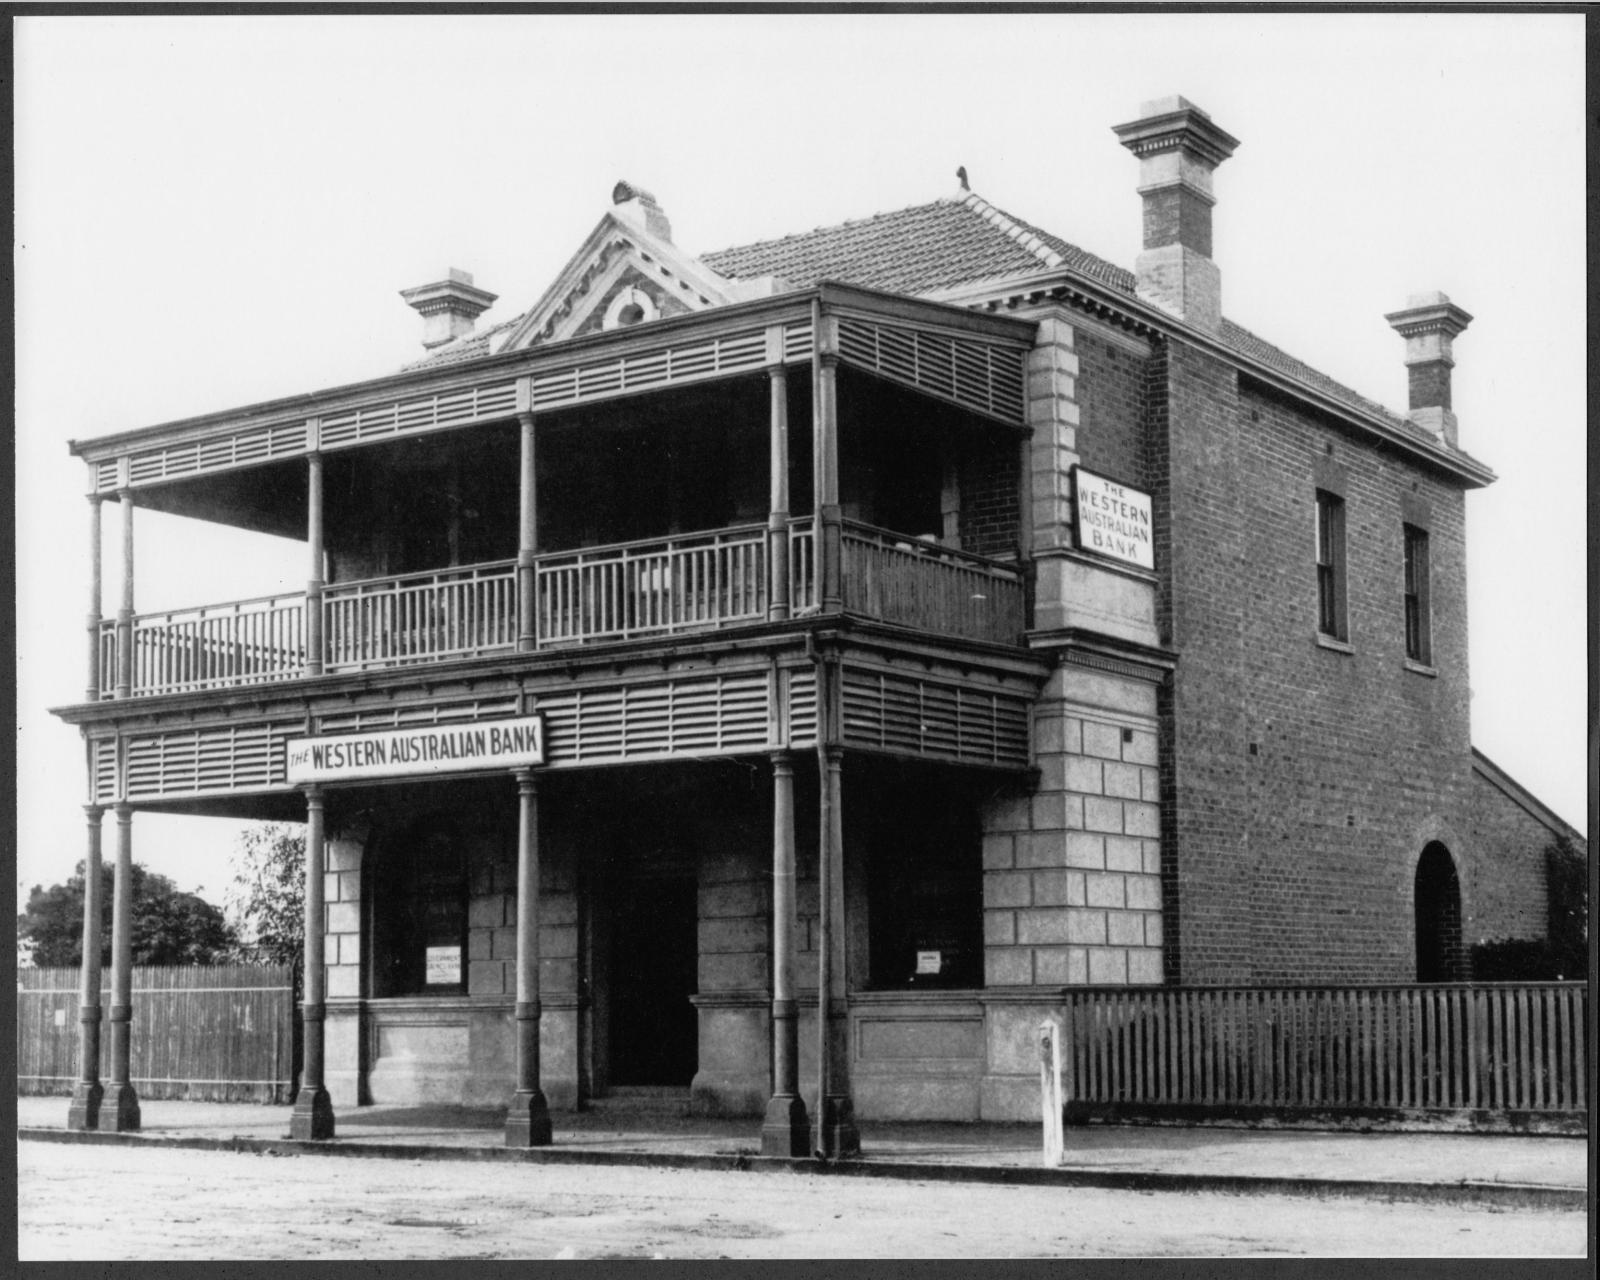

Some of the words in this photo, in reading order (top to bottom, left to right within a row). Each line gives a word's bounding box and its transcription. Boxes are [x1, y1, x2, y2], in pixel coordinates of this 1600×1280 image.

[1080, 488, 1148, 525] WESTERN
[1104, 482, 1125, 498] THE
[1081, 506, 1148, 543] AUSTRALIAN
[1093, 529, 1137, 559] BANK
[290, 749, 310, 767] THE
[312, 739, 386, 769] WESTERN
[390, 731, 486, 766] AUSTRALIAN
[490, 725, 537, 755] BANK
